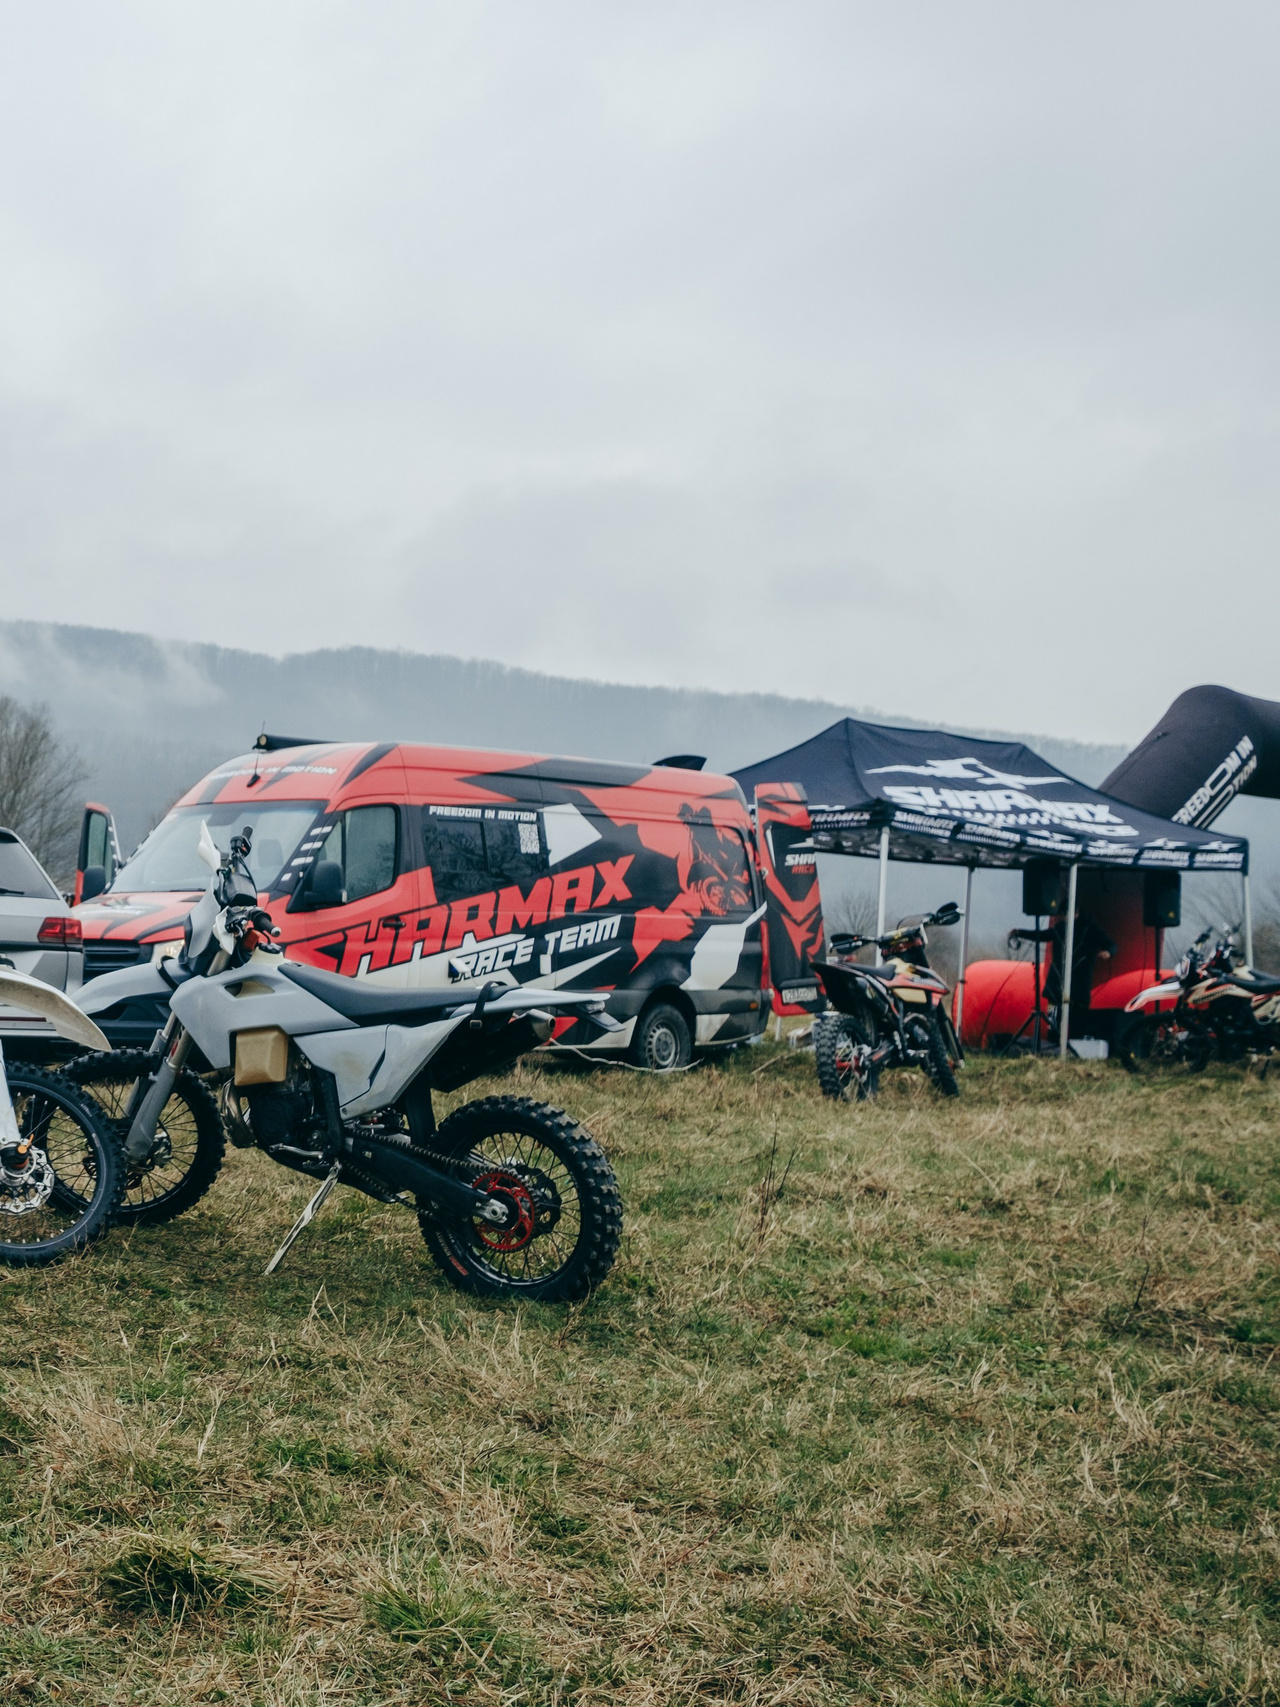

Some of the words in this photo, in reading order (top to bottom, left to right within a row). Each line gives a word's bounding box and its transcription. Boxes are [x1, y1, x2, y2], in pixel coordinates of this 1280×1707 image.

[1192, 754, 1258, 830] OTION
[429, 805, 482, 819] FREEDOM
[484, 809, 495, 820] IN
[498, 810, 537, 822] MOTION
[544, 914, 622, 956] TEAM
